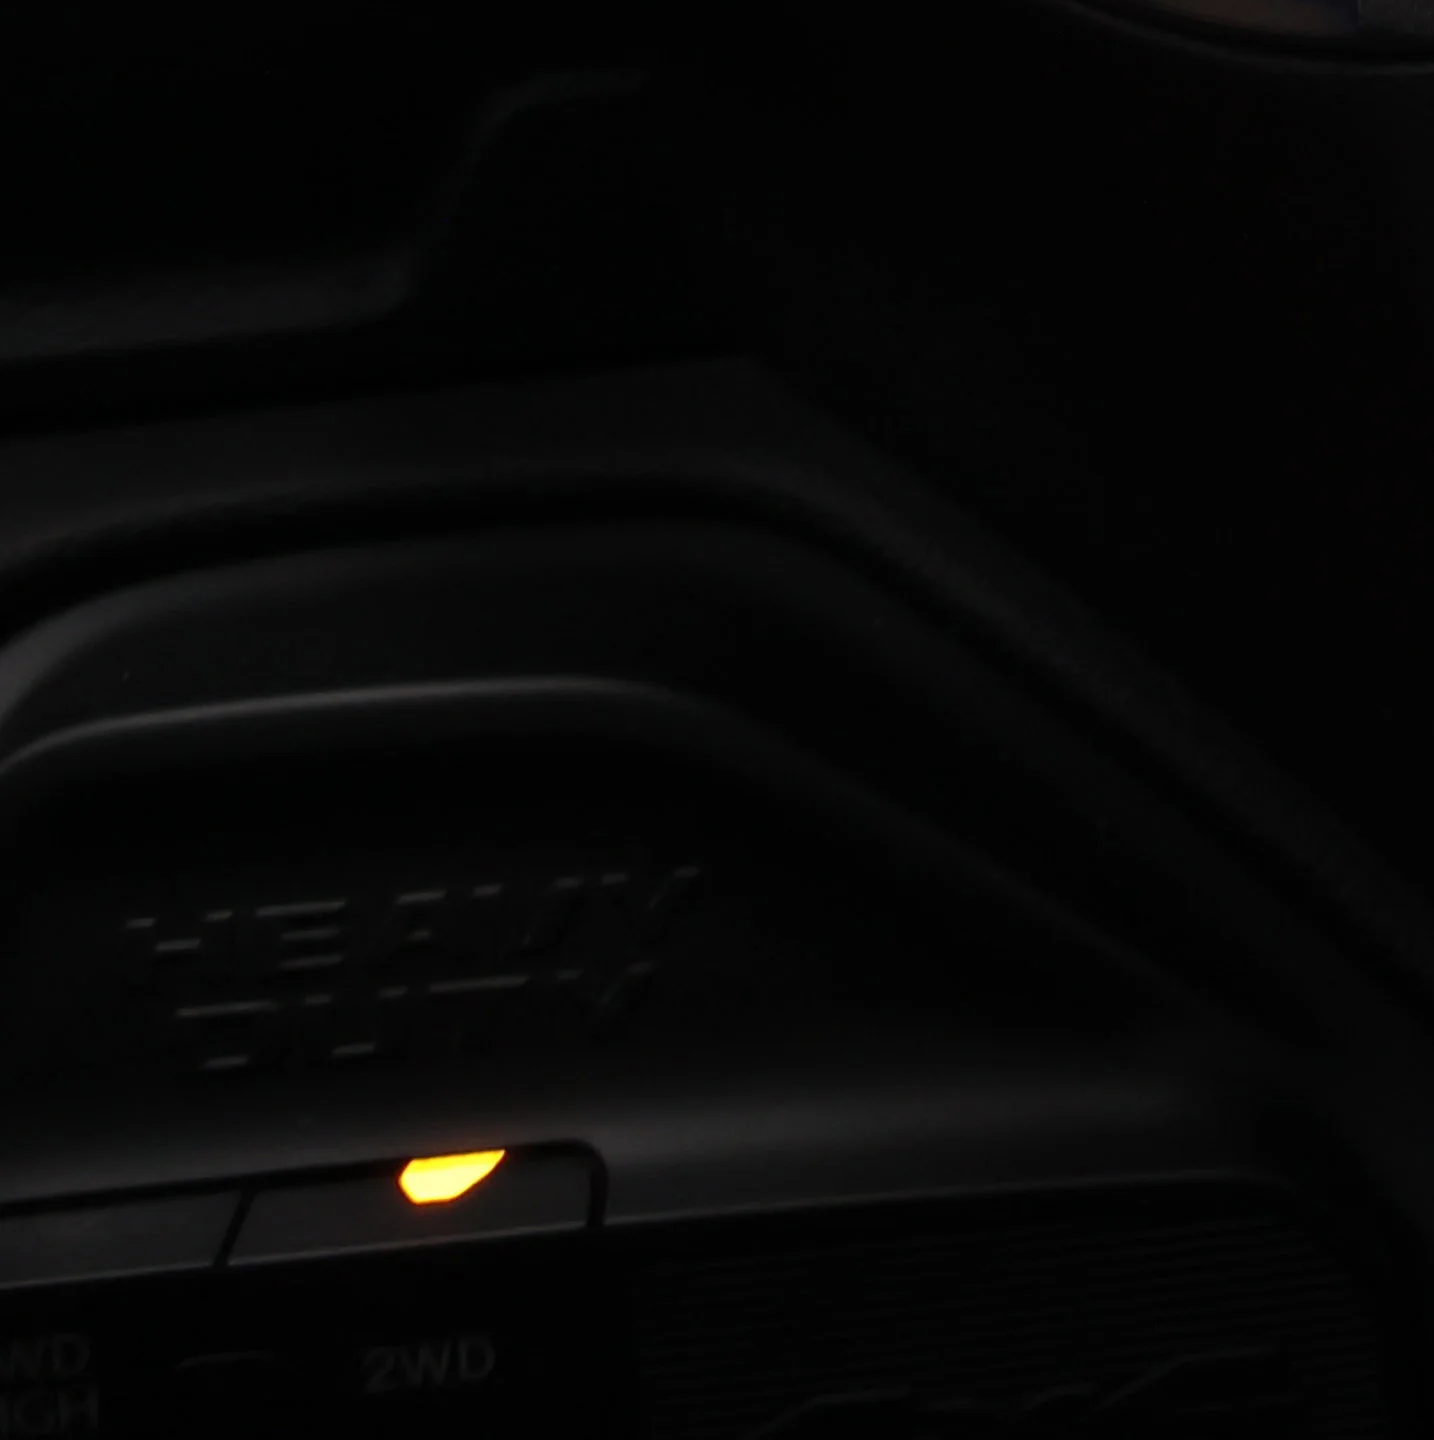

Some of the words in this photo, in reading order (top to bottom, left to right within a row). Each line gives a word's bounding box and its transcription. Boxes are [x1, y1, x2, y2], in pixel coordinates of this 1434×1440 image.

[0, 1332, 91, 1380] WD
[360, 1336, 497, 1393] 2WD
[0, 1383, 100, 1437] IGH
